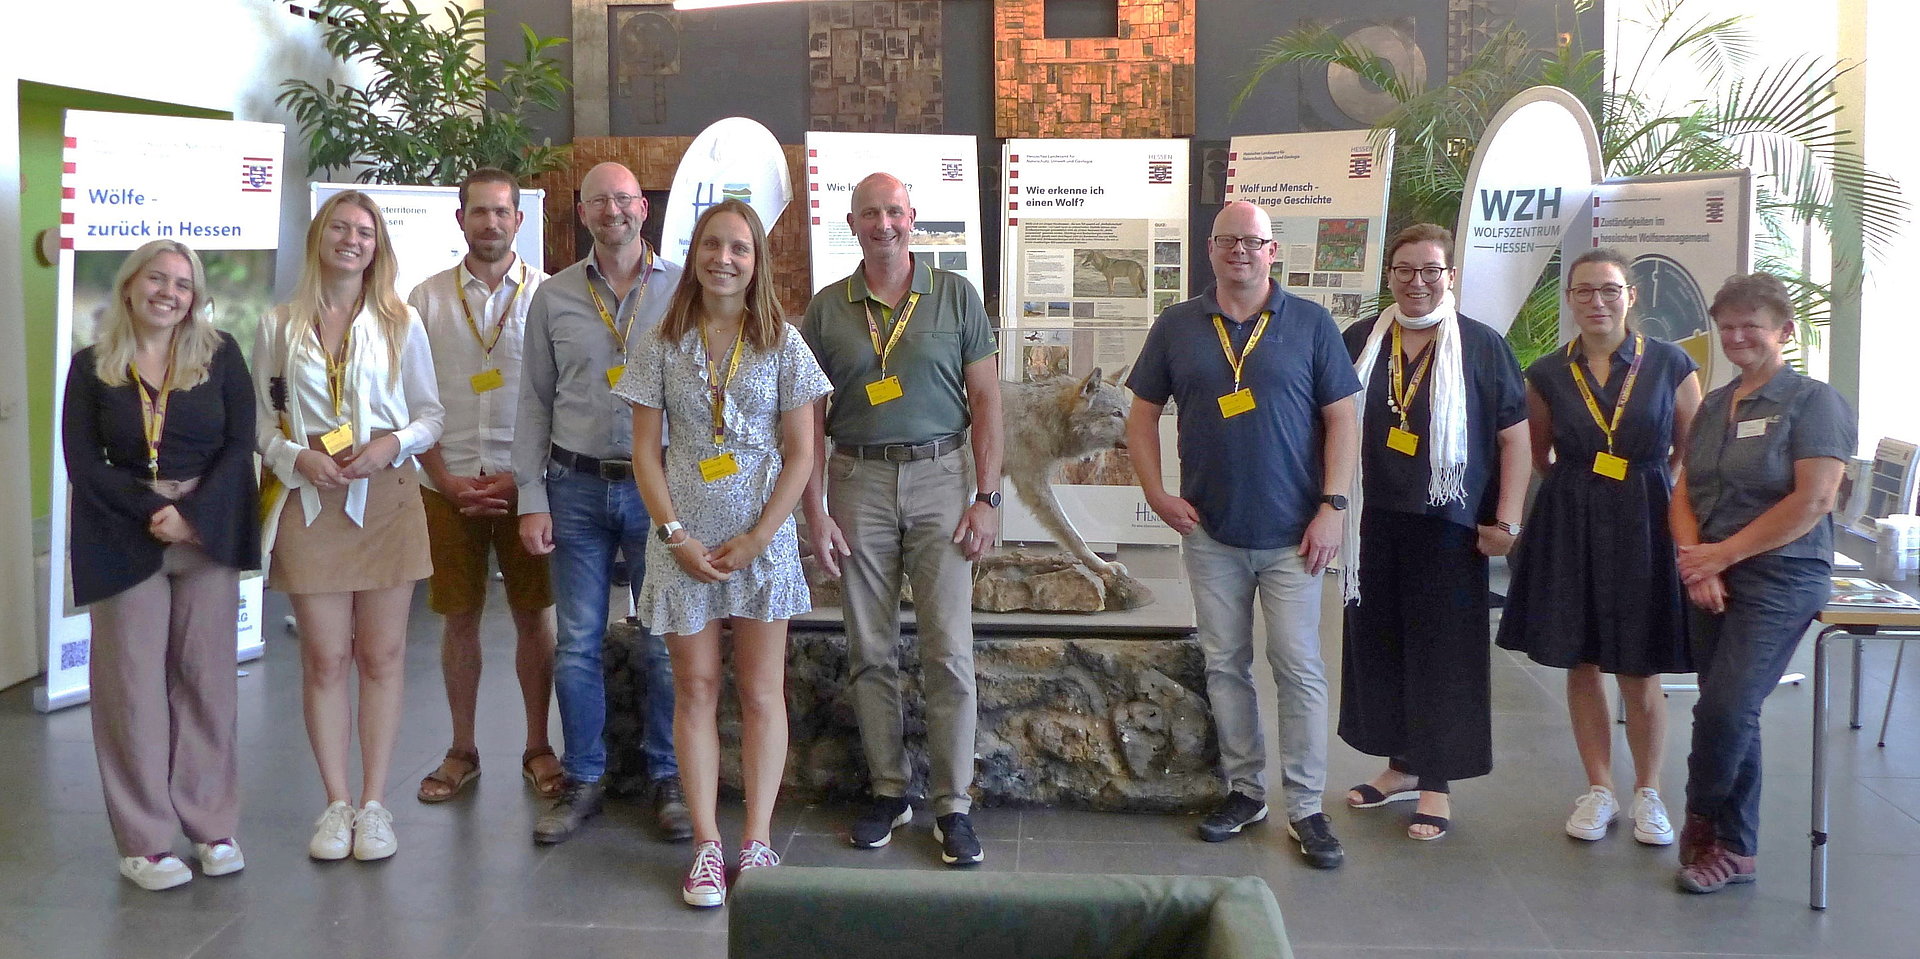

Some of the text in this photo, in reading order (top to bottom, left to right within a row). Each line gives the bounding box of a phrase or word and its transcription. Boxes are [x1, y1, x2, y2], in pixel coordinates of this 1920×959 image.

[827, 182, 846, 192] Wie
[1026, 185, 1104, 195] Wie erkenne ich
[1240, 184, 1260, 193] Wolf
[1261, 183, 1277, 192] und
[1280, 182, 1313, 192] Mensch
[88, 188, 145, 206] Wölfe
[1026, 198, 1085, 207] einen Wolf?
[1258, 196, 1282, 207] lange
[1283, 195, 1332, 205] Geschichte
[379, 206, 427, 214] sterritorien
[1480, 187, 1562, 221] WZH
[87, 220, 242, 237] zurück in Hessen
[1600, 216, 1665, 229] Zuständigkeiten im
[1474, 225, 1560, 238] WOLFSZENTRUM
[1600, 233, 1710, 245] hessischen Wolfsmanagement
[1495, 242, 1535, 253] HESSEN
